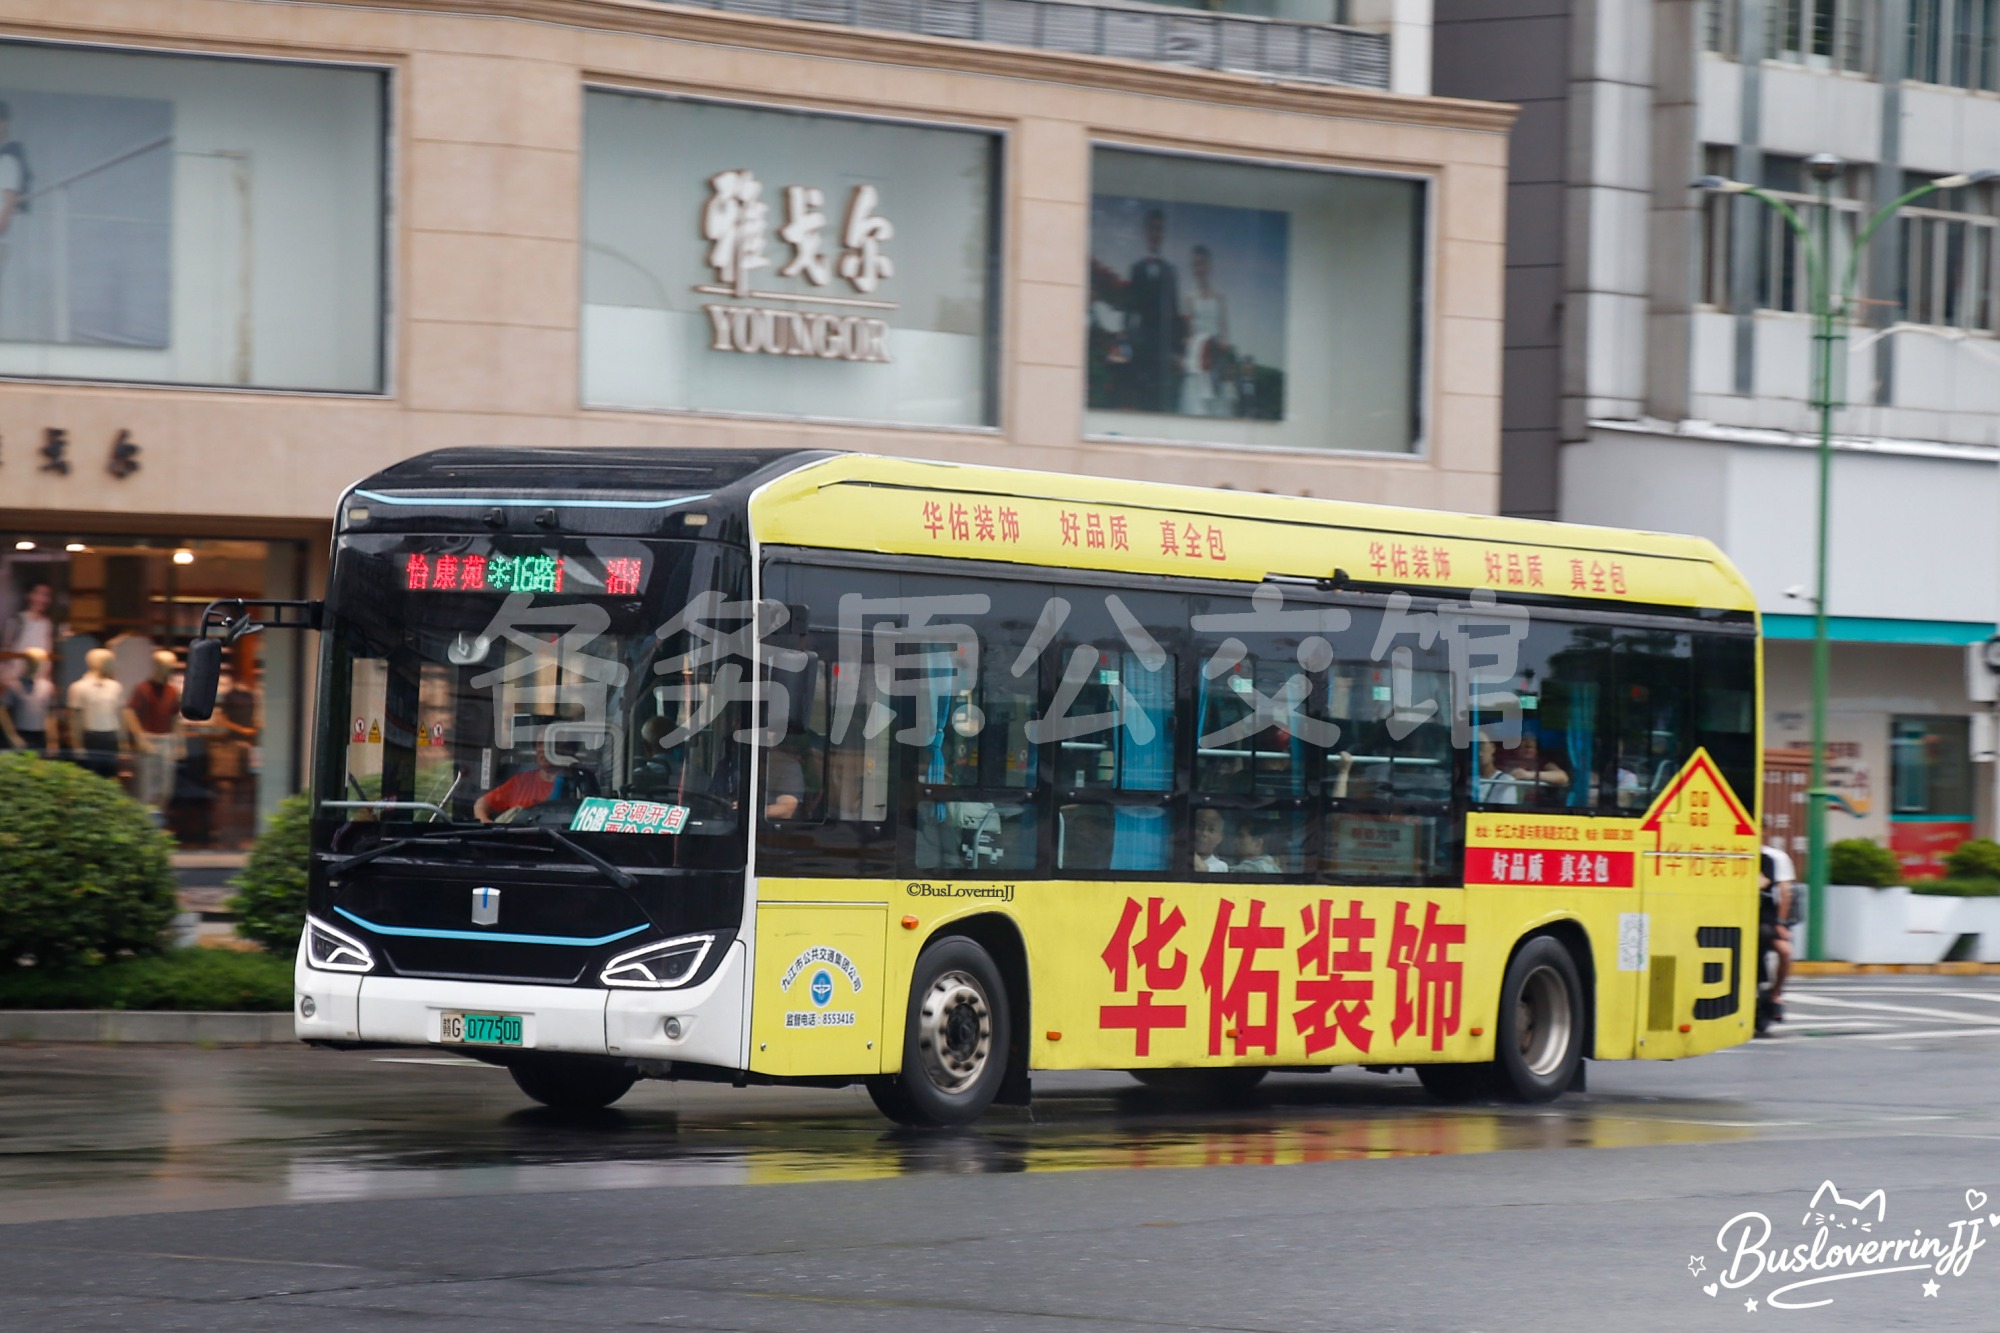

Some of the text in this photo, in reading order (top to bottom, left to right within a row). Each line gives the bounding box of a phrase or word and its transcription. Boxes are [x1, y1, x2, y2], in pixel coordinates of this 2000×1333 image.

[704, 304, 893, 363] YOUNGOR
[922, 499, 1227, 561] 华佑装饰 好品质 真全包
[406, 553, 486, 591] 怡康苑
[510, 554, 557, 592] 16路
[1369, 541, 1627, 595] 华佑装饰 好品质 真全包
[609, 801, 685, 829] 空调开启
[1492, 851, 1610, 883] 好品质 真全包
[781, 946, 862, 992] 九江市公共交通集团公司
[1099, 896, 1467, 1058] 华佑装饰
